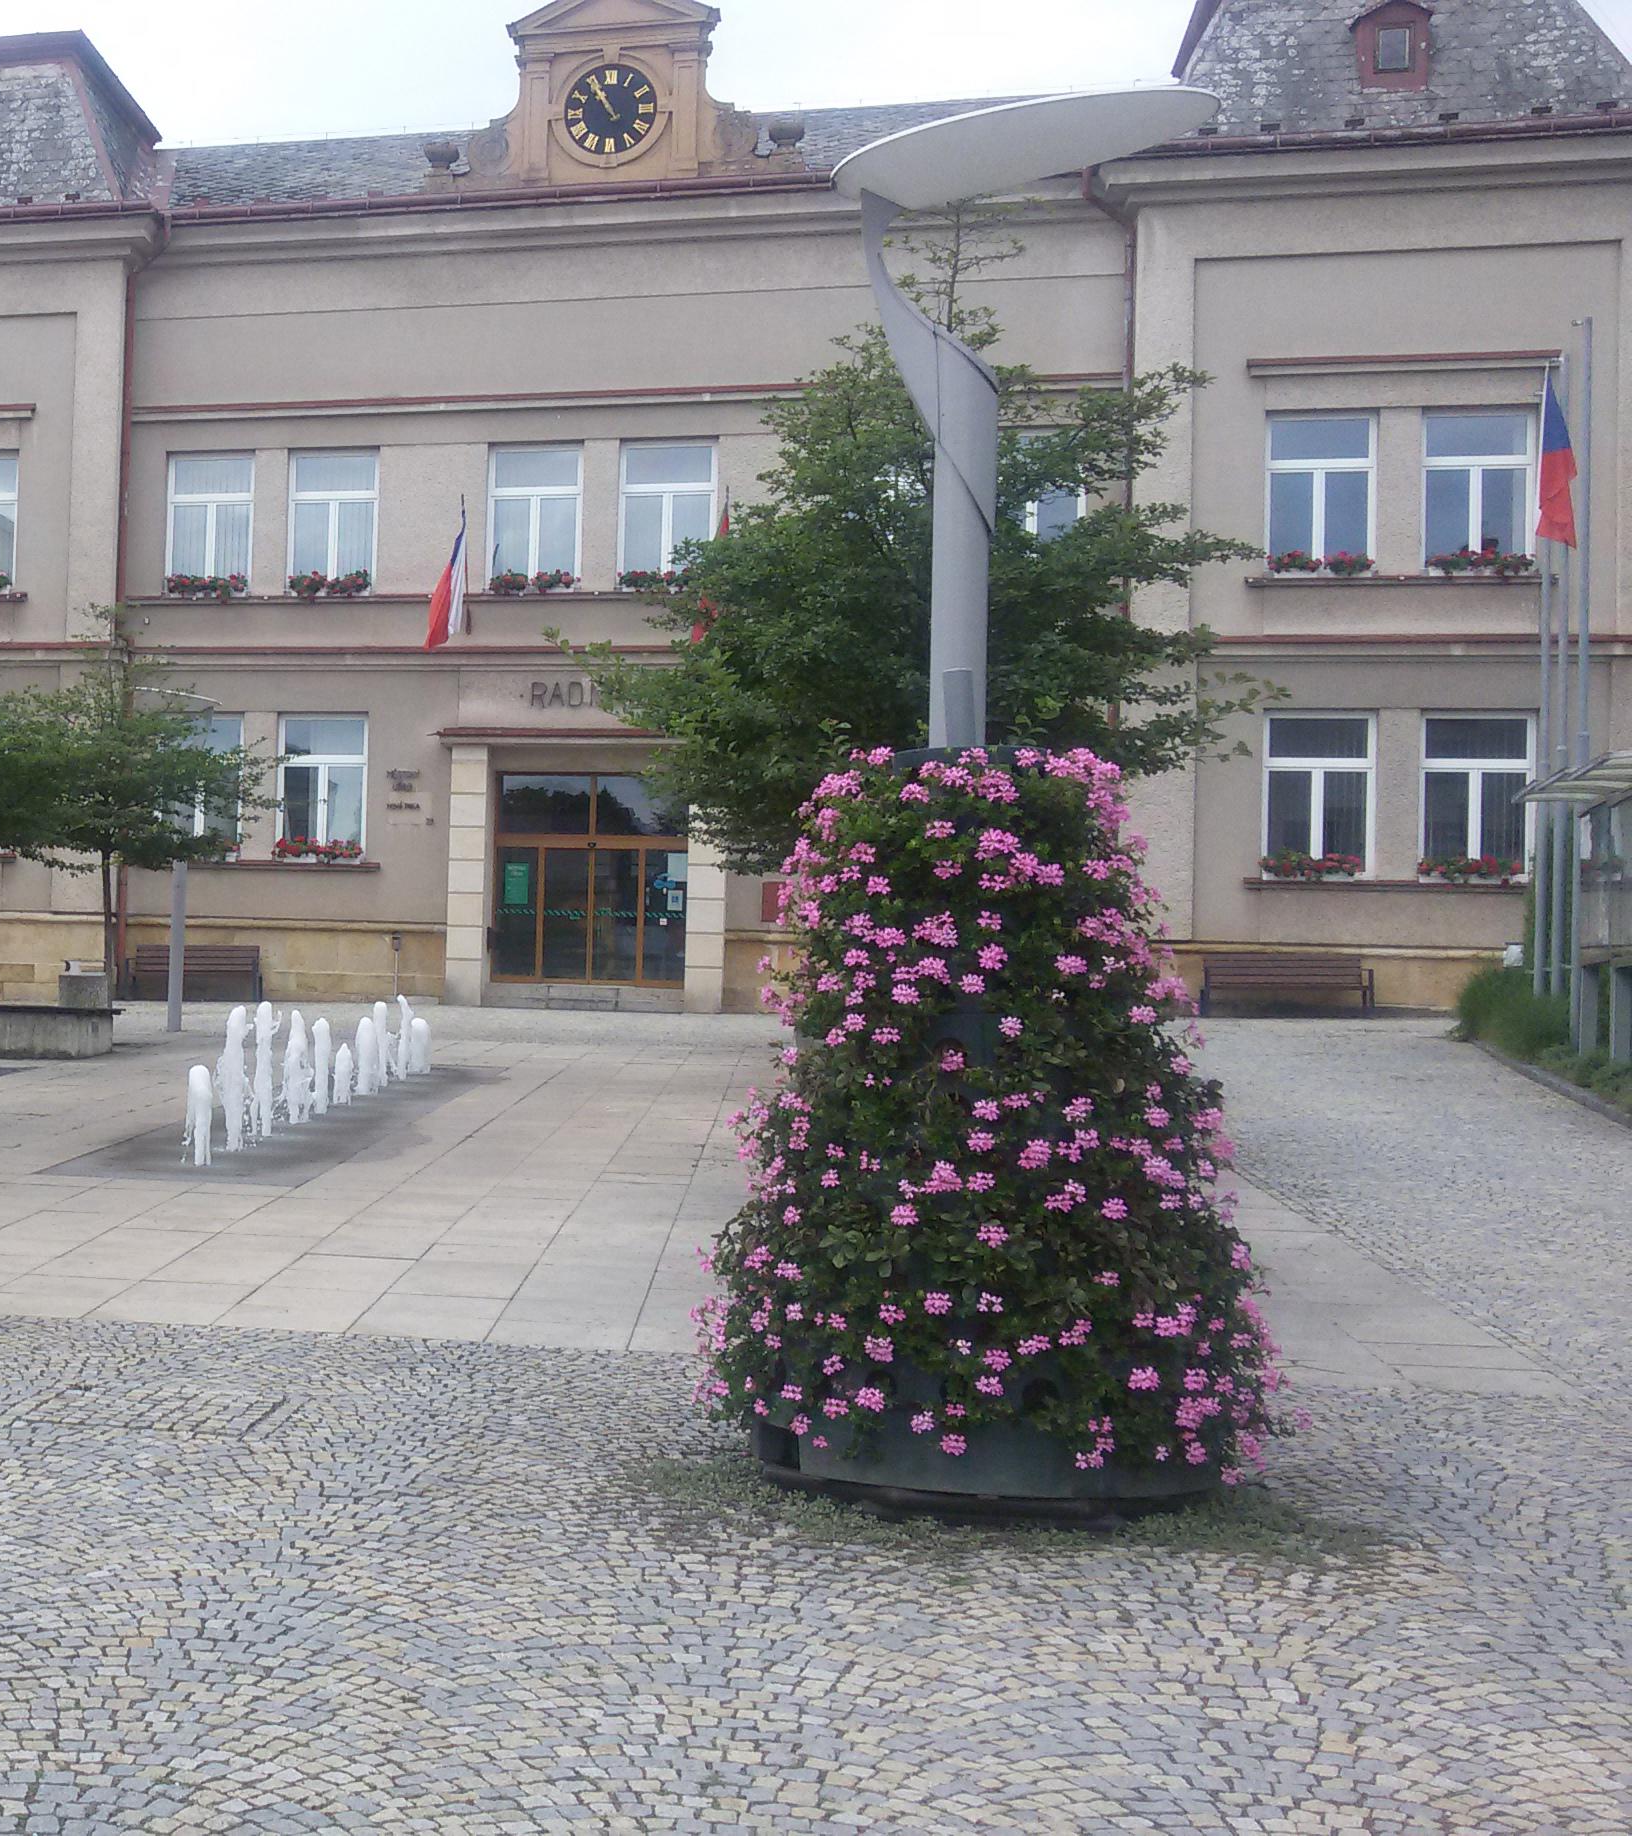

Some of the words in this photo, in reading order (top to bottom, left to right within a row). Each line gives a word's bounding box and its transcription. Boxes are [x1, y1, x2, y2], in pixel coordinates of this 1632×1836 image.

[605, 70, 618, 85] XII
[624, 73, 634, 87] I
[572, 90, 588, 103] X
[634, 85, 650, 99] II
[568, 107, 583, 119] IX
[638, 103, 654, 114] III
[604, 138, 615, 152] VI
[623, 132, 635, 147] V
